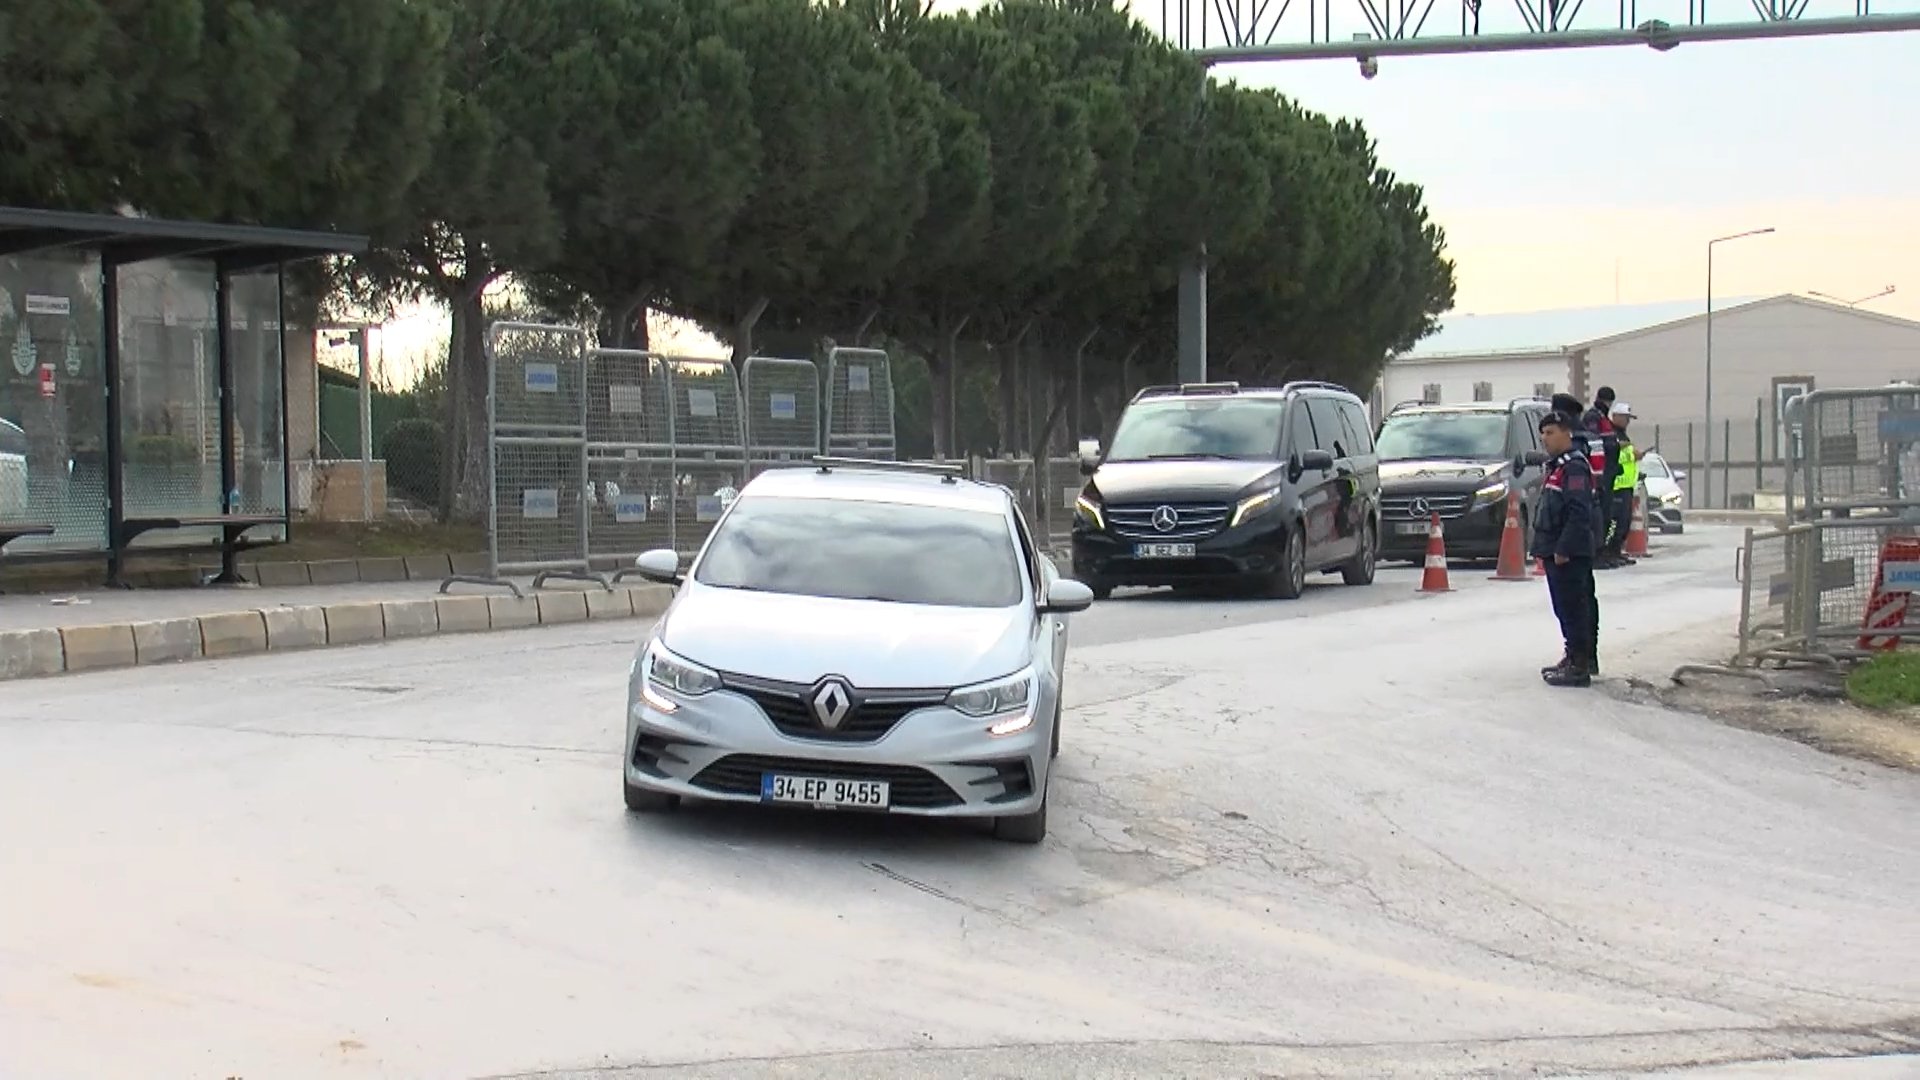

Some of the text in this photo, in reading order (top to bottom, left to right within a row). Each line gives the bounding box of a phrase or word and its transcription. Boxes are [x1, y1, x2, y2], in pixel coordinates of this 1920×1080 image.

[774, 777, 796, 799] 34
[803, 778, 828, 801] EP
[834, 781, 881, 805] 9455
